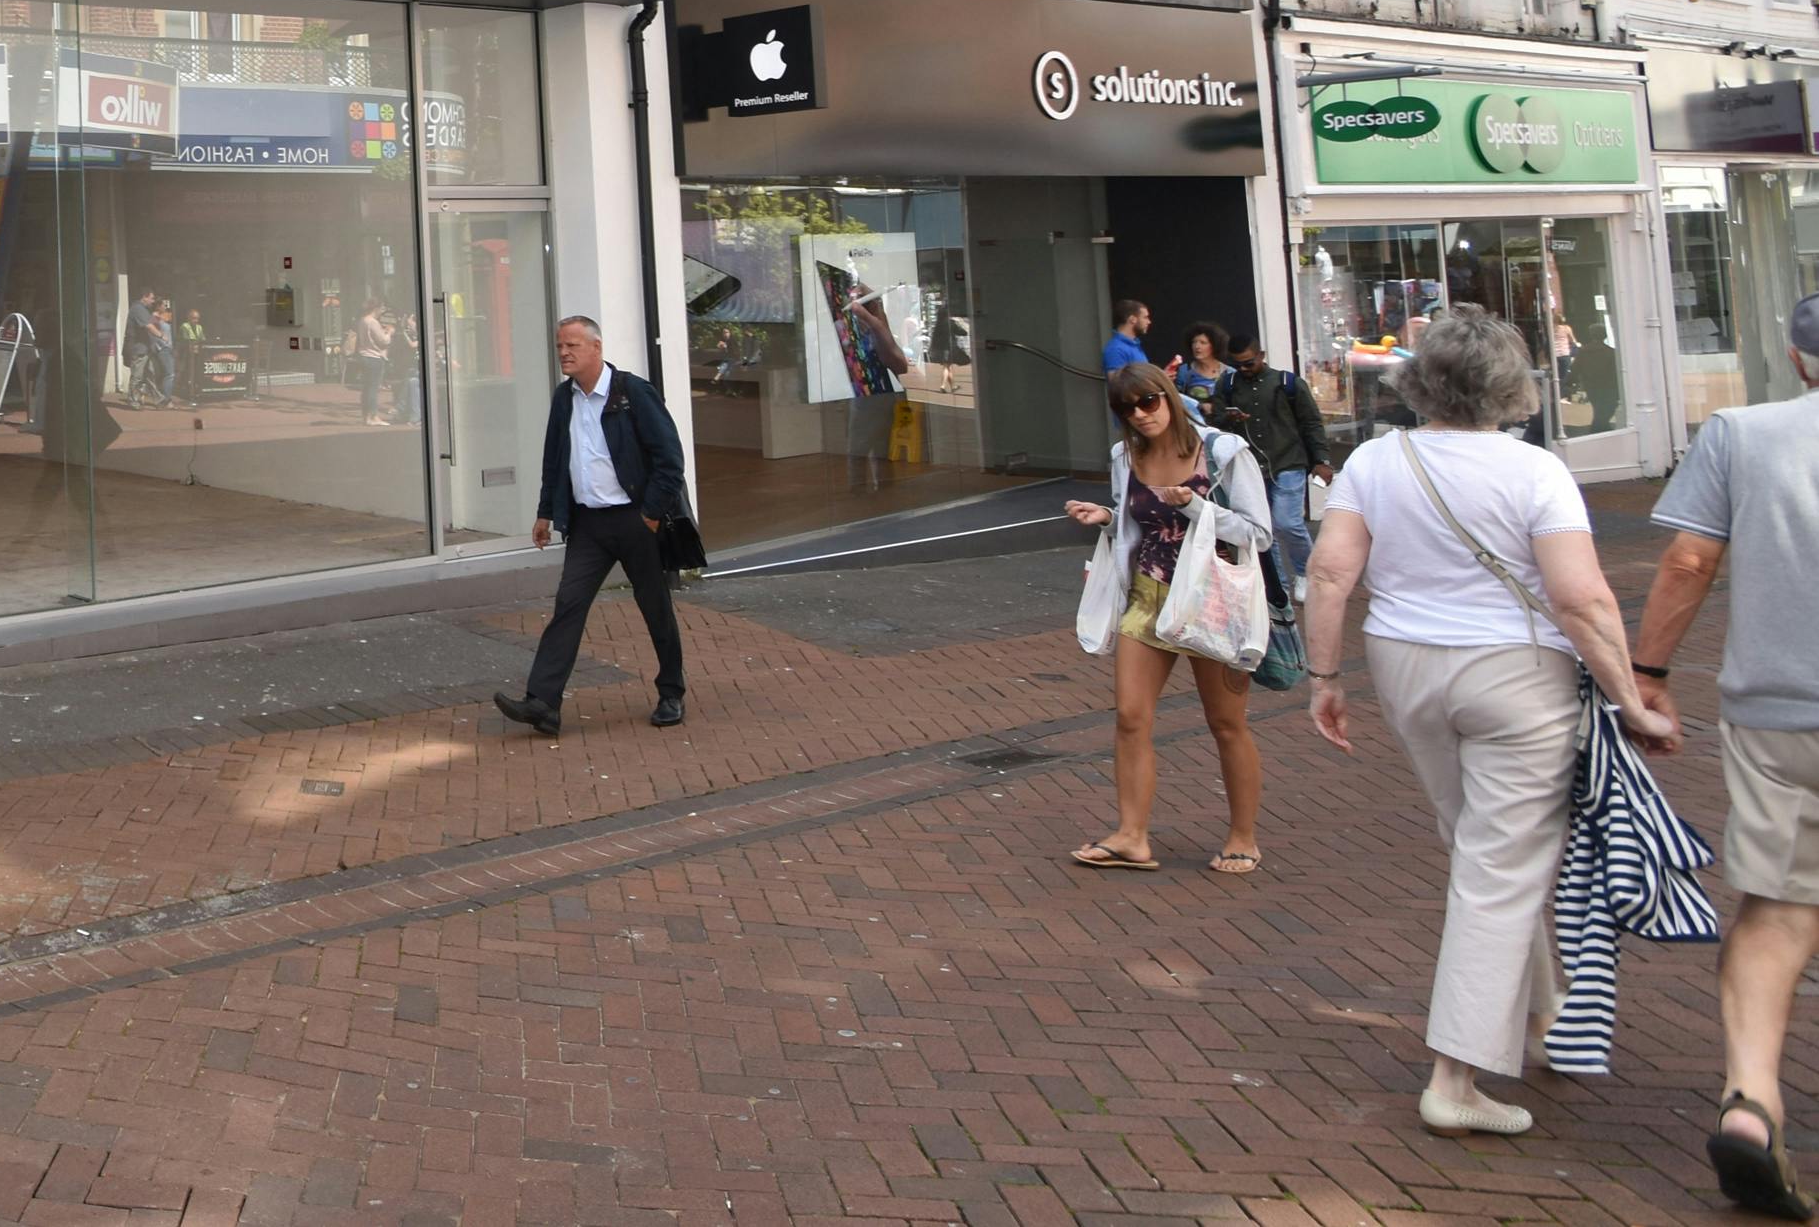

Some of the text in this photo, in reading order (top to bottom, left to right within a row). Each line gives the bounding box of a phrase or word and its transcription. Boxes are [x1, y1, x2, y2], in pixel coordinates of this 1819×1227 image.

[734, 91, 809, 107] Premium Reseller
[1093, 66, 1243, 106] solutions inc.
[1323, 108, 1426, 132] Specsavers
[1484, 114, 1559, 152] Specsavers
[1572, 120, 1624, 149] Opticians
